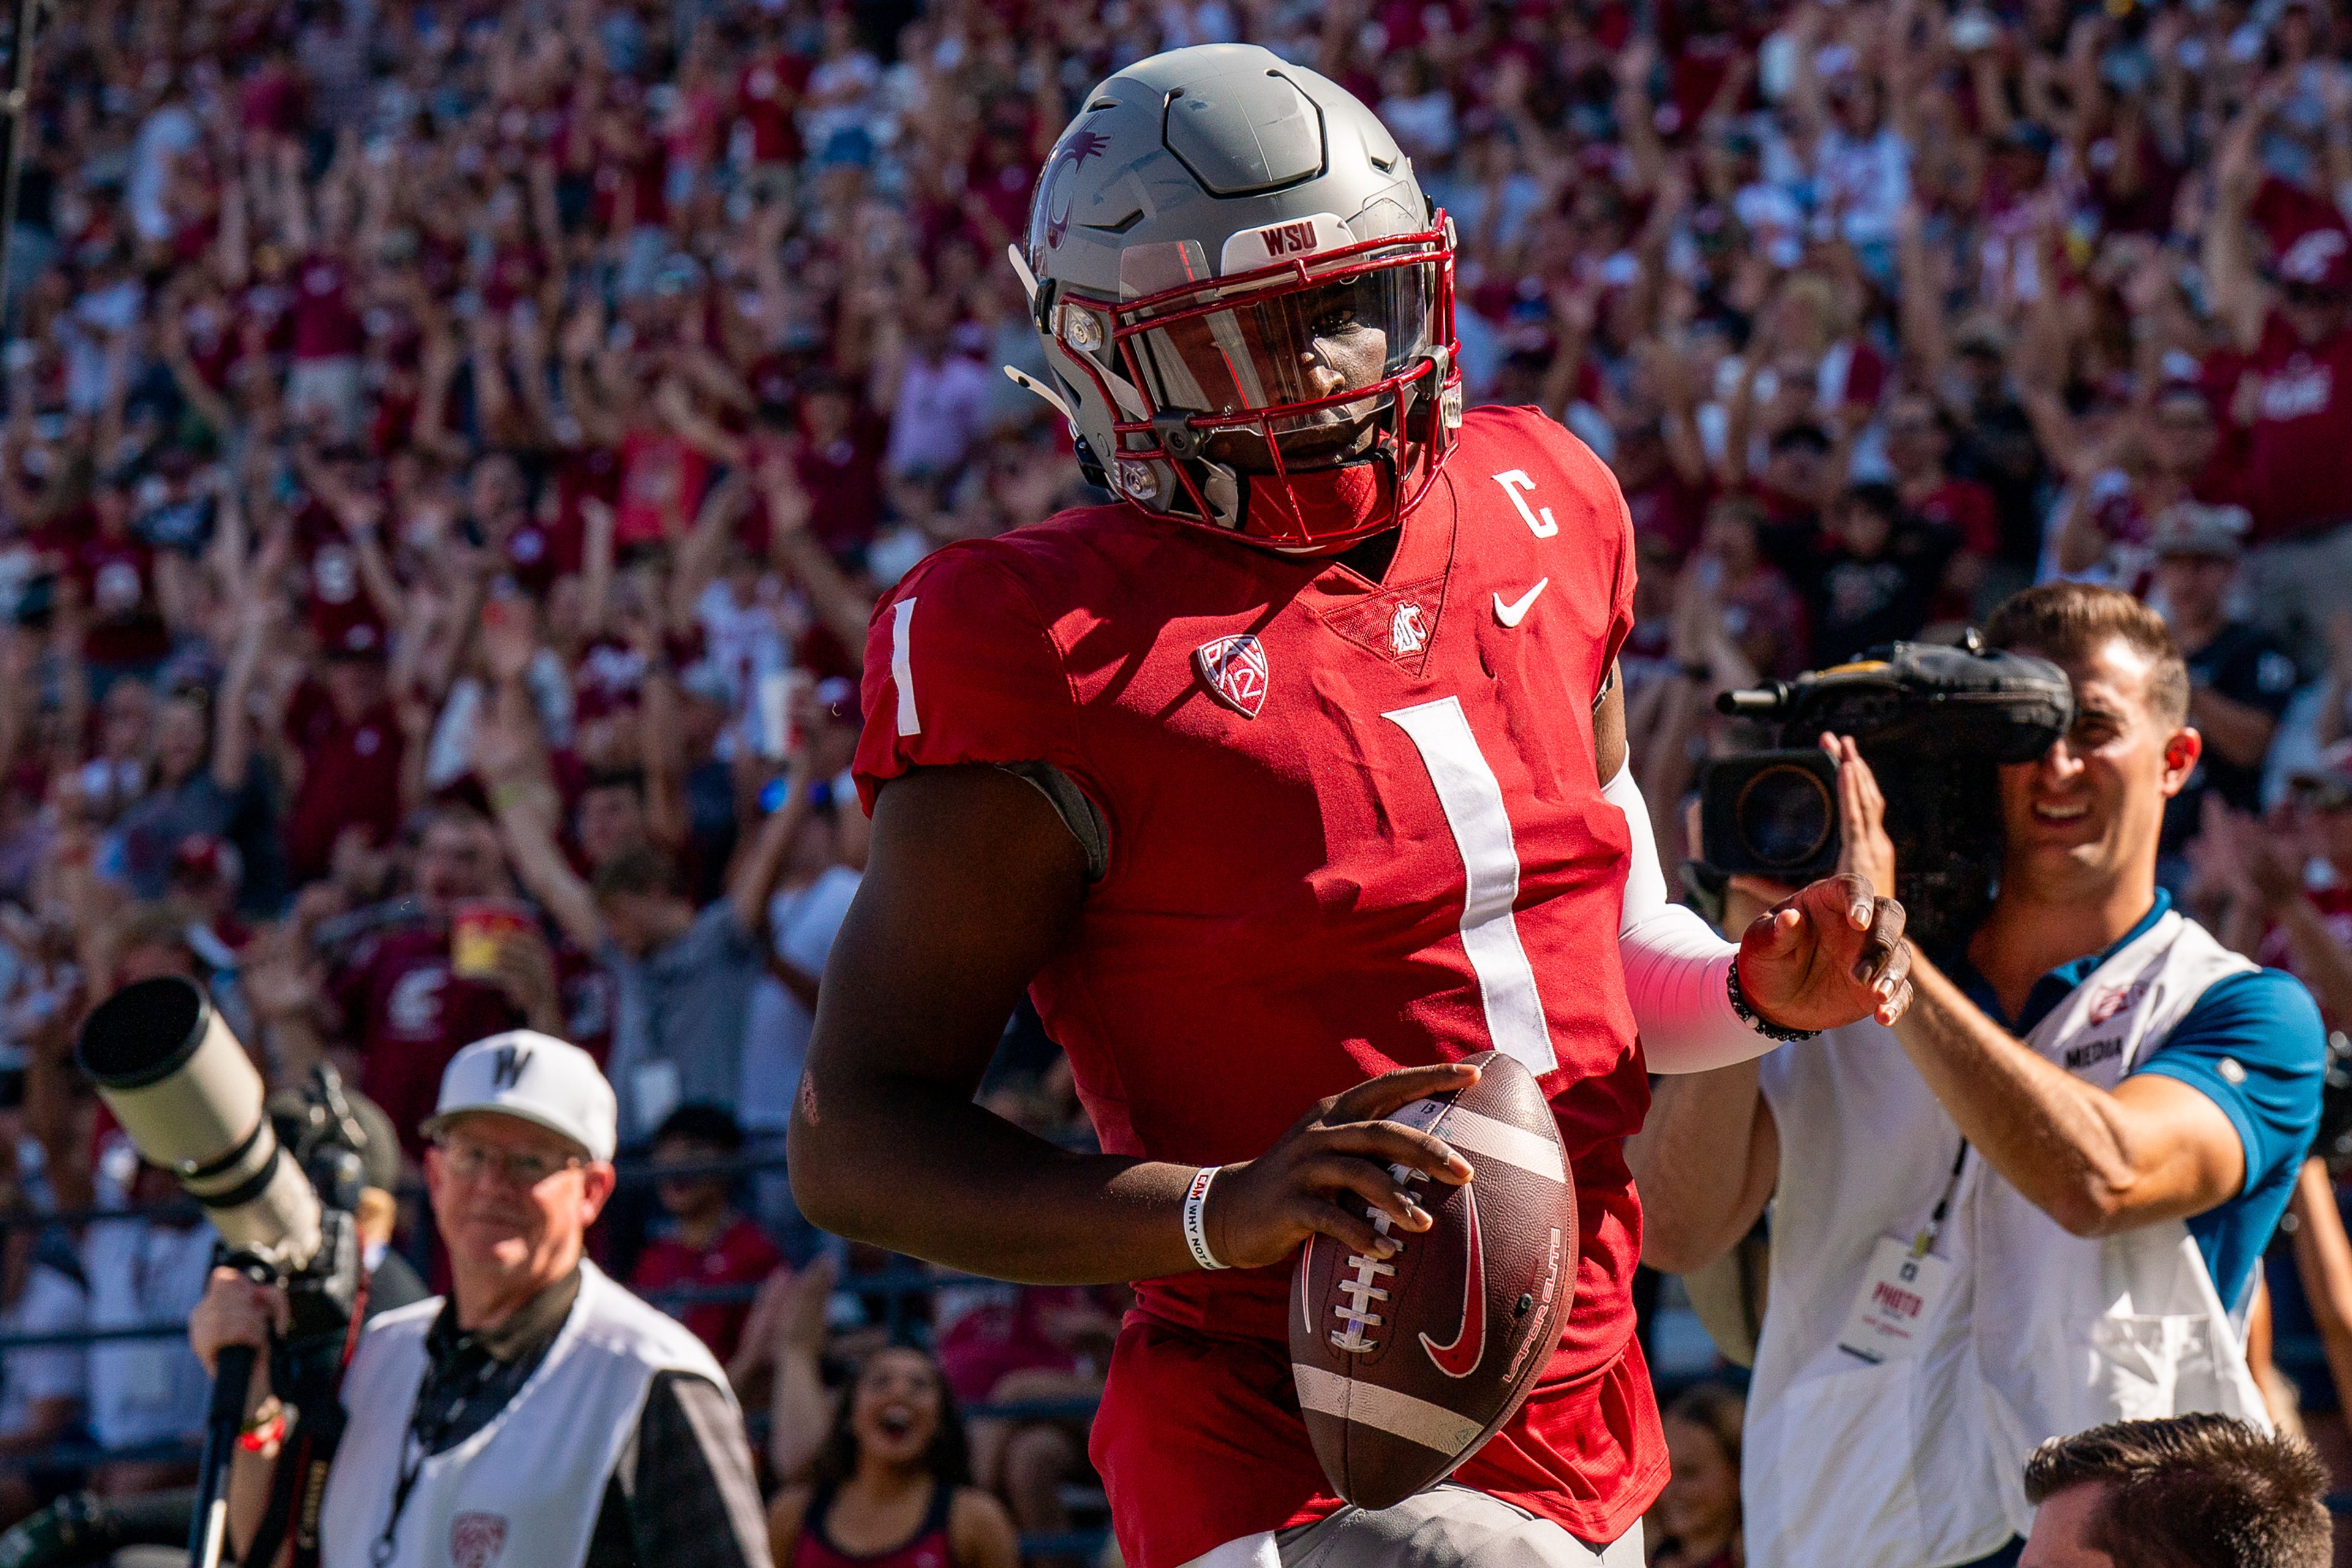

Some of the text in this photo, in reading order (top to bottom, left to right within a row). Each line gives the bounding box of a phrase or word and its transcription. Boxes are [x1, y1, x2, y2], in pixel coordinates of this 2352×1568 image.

[1260, 221, 1317, 257] WSU
[1491, 469, 1559, 538] C
[891, 597, 921, 737] 1
[1202, 638, 1265, 690] PAC
[1227, 668, 1262, 704] 12
[1380, 695, 1559, 1077] 1
[492, 1046, 532, 1088] W
[2065, 1036, 2122, 1069] MEDIA
[1189, 1174, 1210, 1202] CAM
[1188, 1204, 1197, 1234] WHY
[1191, 1237, 1207, 1261] NOT
[1502, 1227, 1561, 1383] VAPOR ELITE
[1872, 1281, 1924, 1318] PHOTO
